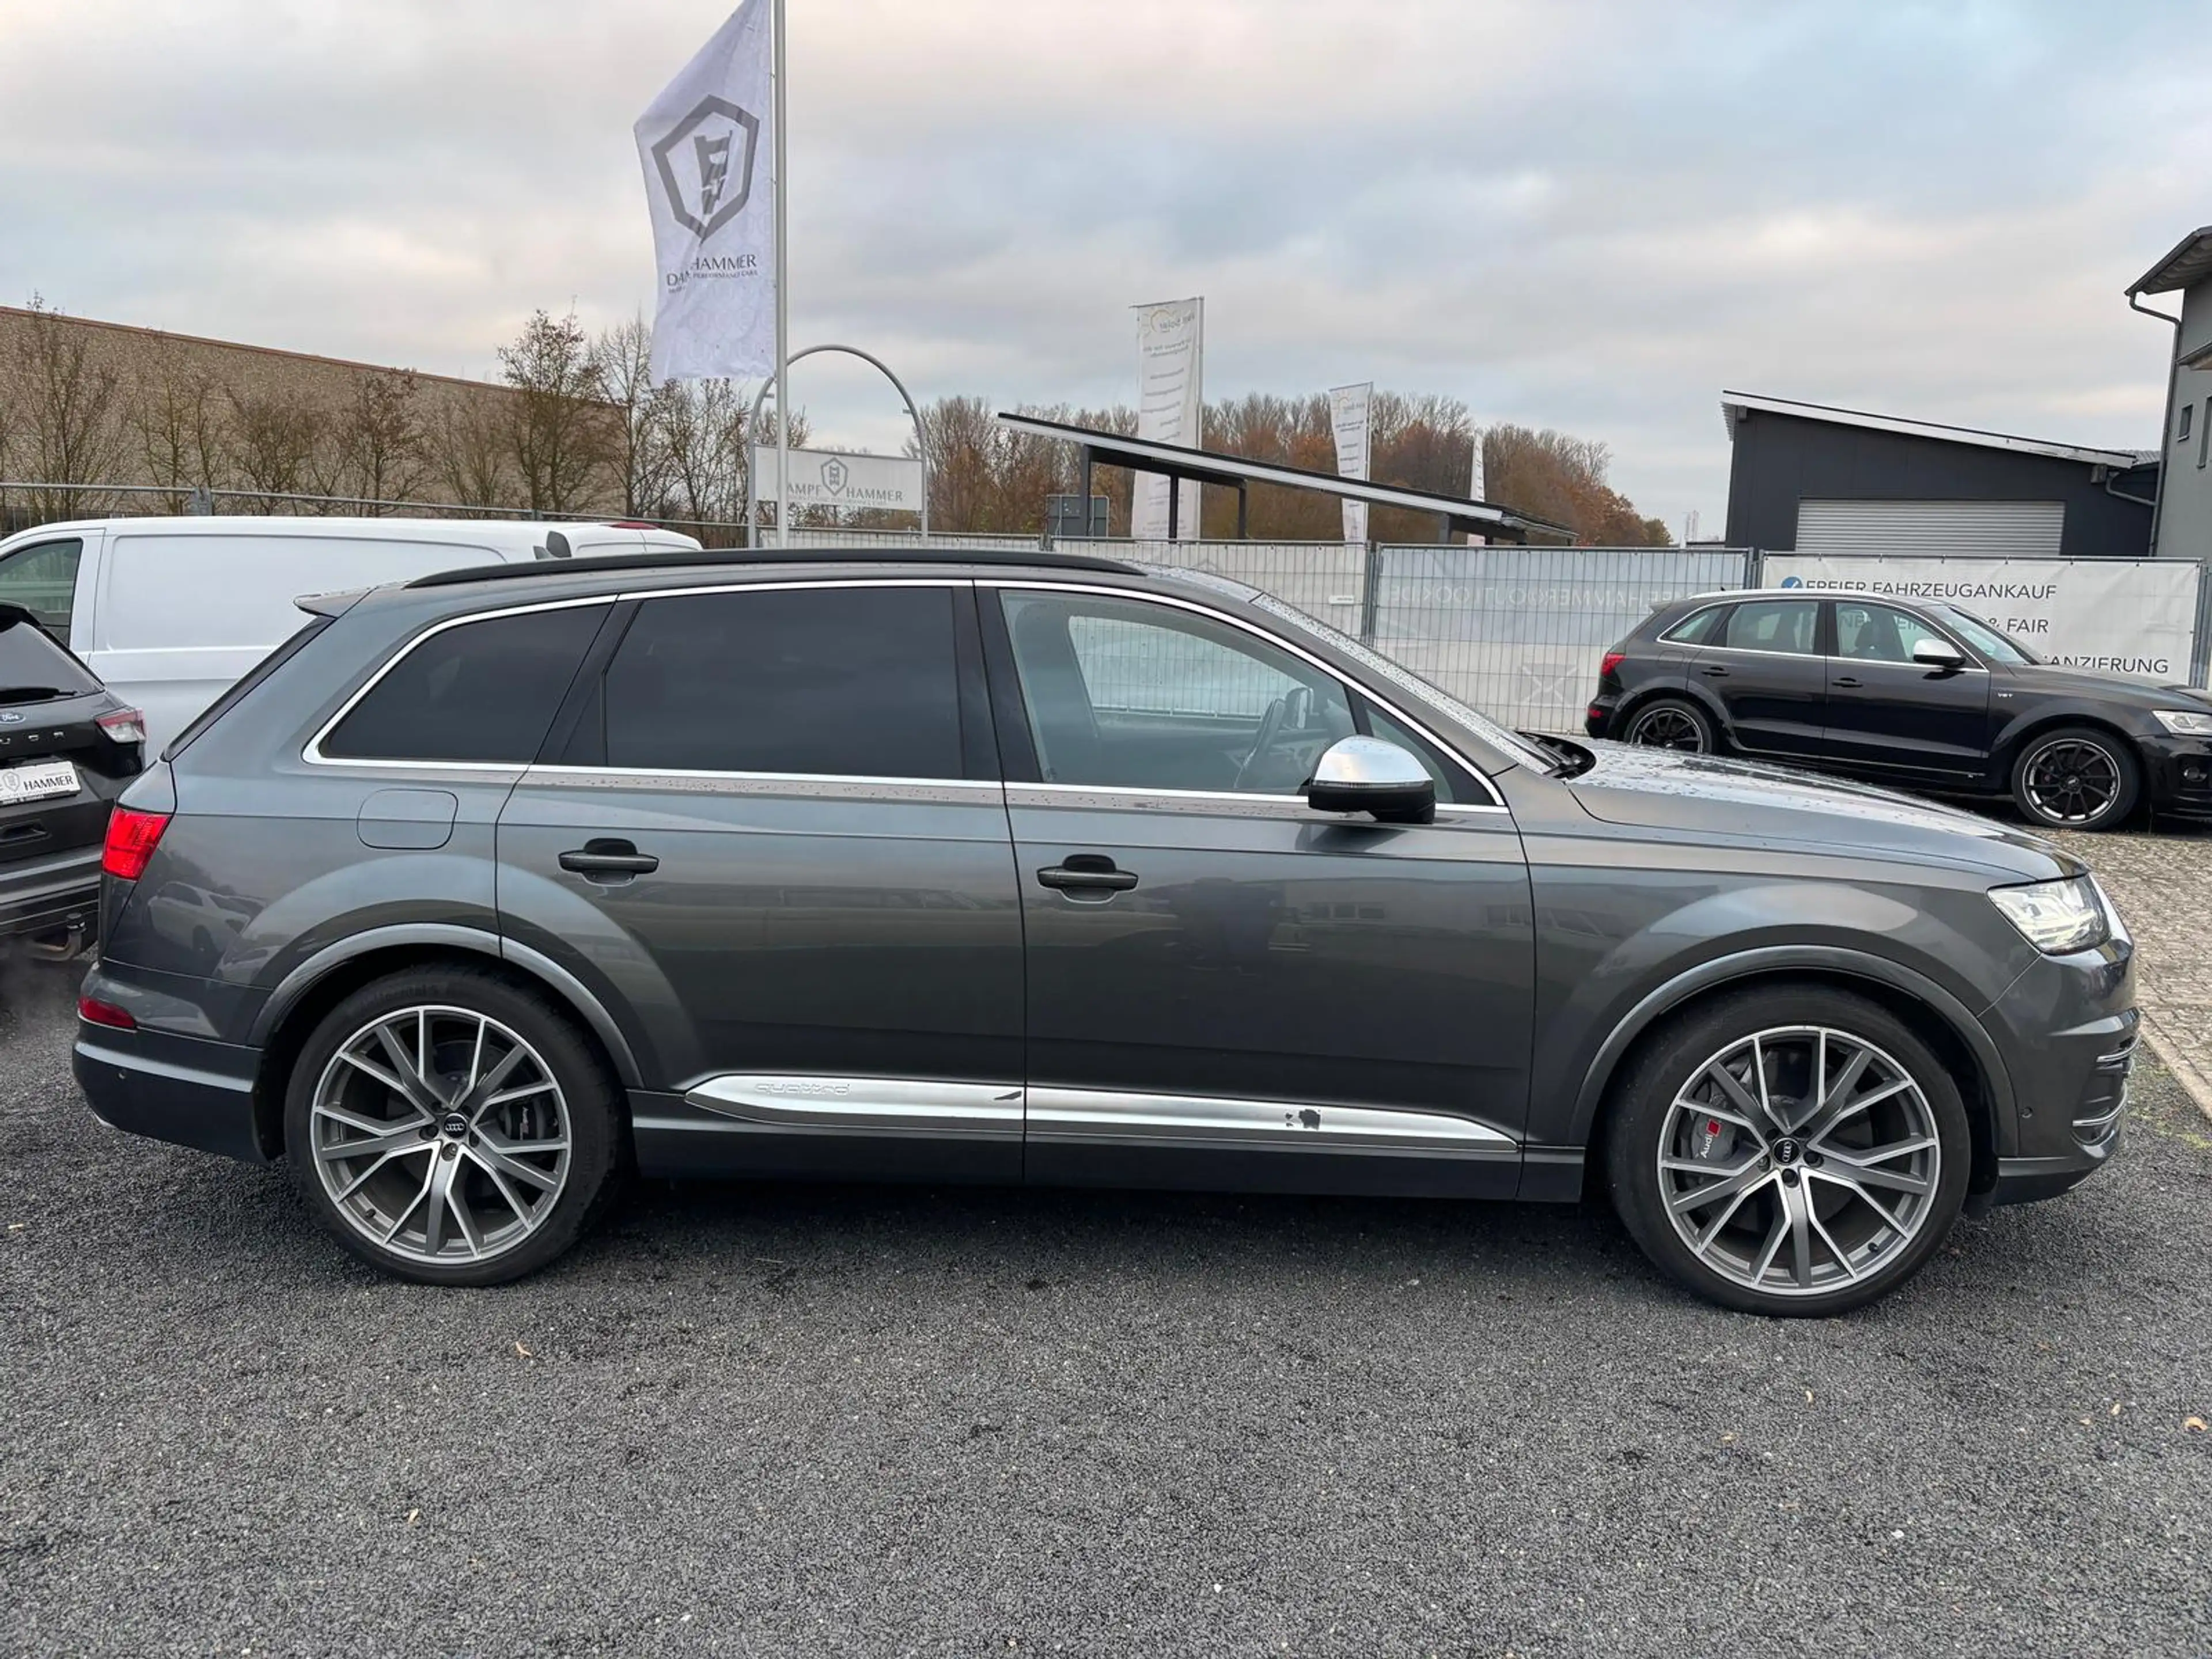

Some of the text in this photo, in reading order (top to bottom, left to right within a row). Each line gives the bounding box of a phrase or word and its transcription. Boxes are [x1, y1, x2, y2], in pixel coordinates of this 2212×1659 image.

[691, 254, 757, 270] HAMMER
[781, 483, 823, 498] AMPF
[846, 486, 903, 503] HAMMER
[1872, 581, 2057, 599] FAHRZEUGANKAUF
[2007, 618, 2049, 633] FAIR
[2044, 654, 2169, 674] ANZIERUNG
[24, 776, 74, 791] HAMMER
[1700, 1134, 1713, 1158] Audi
